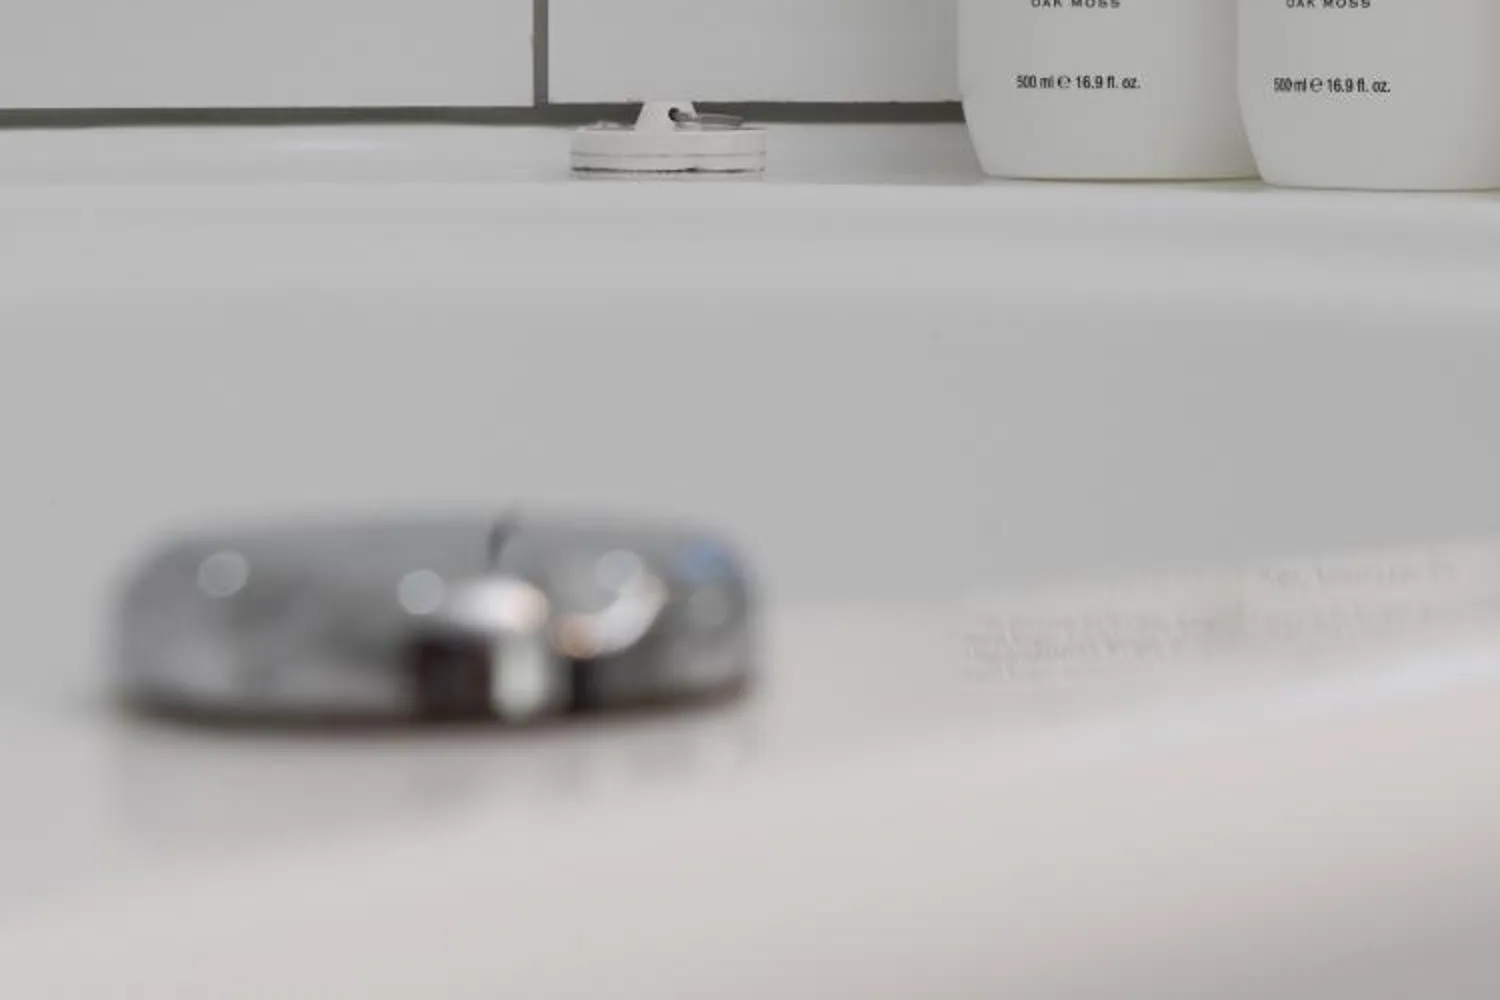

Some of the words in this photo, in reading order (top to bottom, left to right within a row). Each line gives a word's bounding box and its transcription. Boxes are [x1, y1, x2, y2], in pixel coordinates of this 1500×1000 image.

[1016, 74, 1037, 89] 500
[1075, 74, 1103, 89] 16.9
[1107, 74, 1119, 89] fl.
[1121, 76, 1141, 89] oz.
[1273, 77, 1293, 92] 500
[1327, 77, 1353, 93] 16.9
[1357, 77, 1369, 93] fl.
[1371, 80, 1391, 93] oz.
